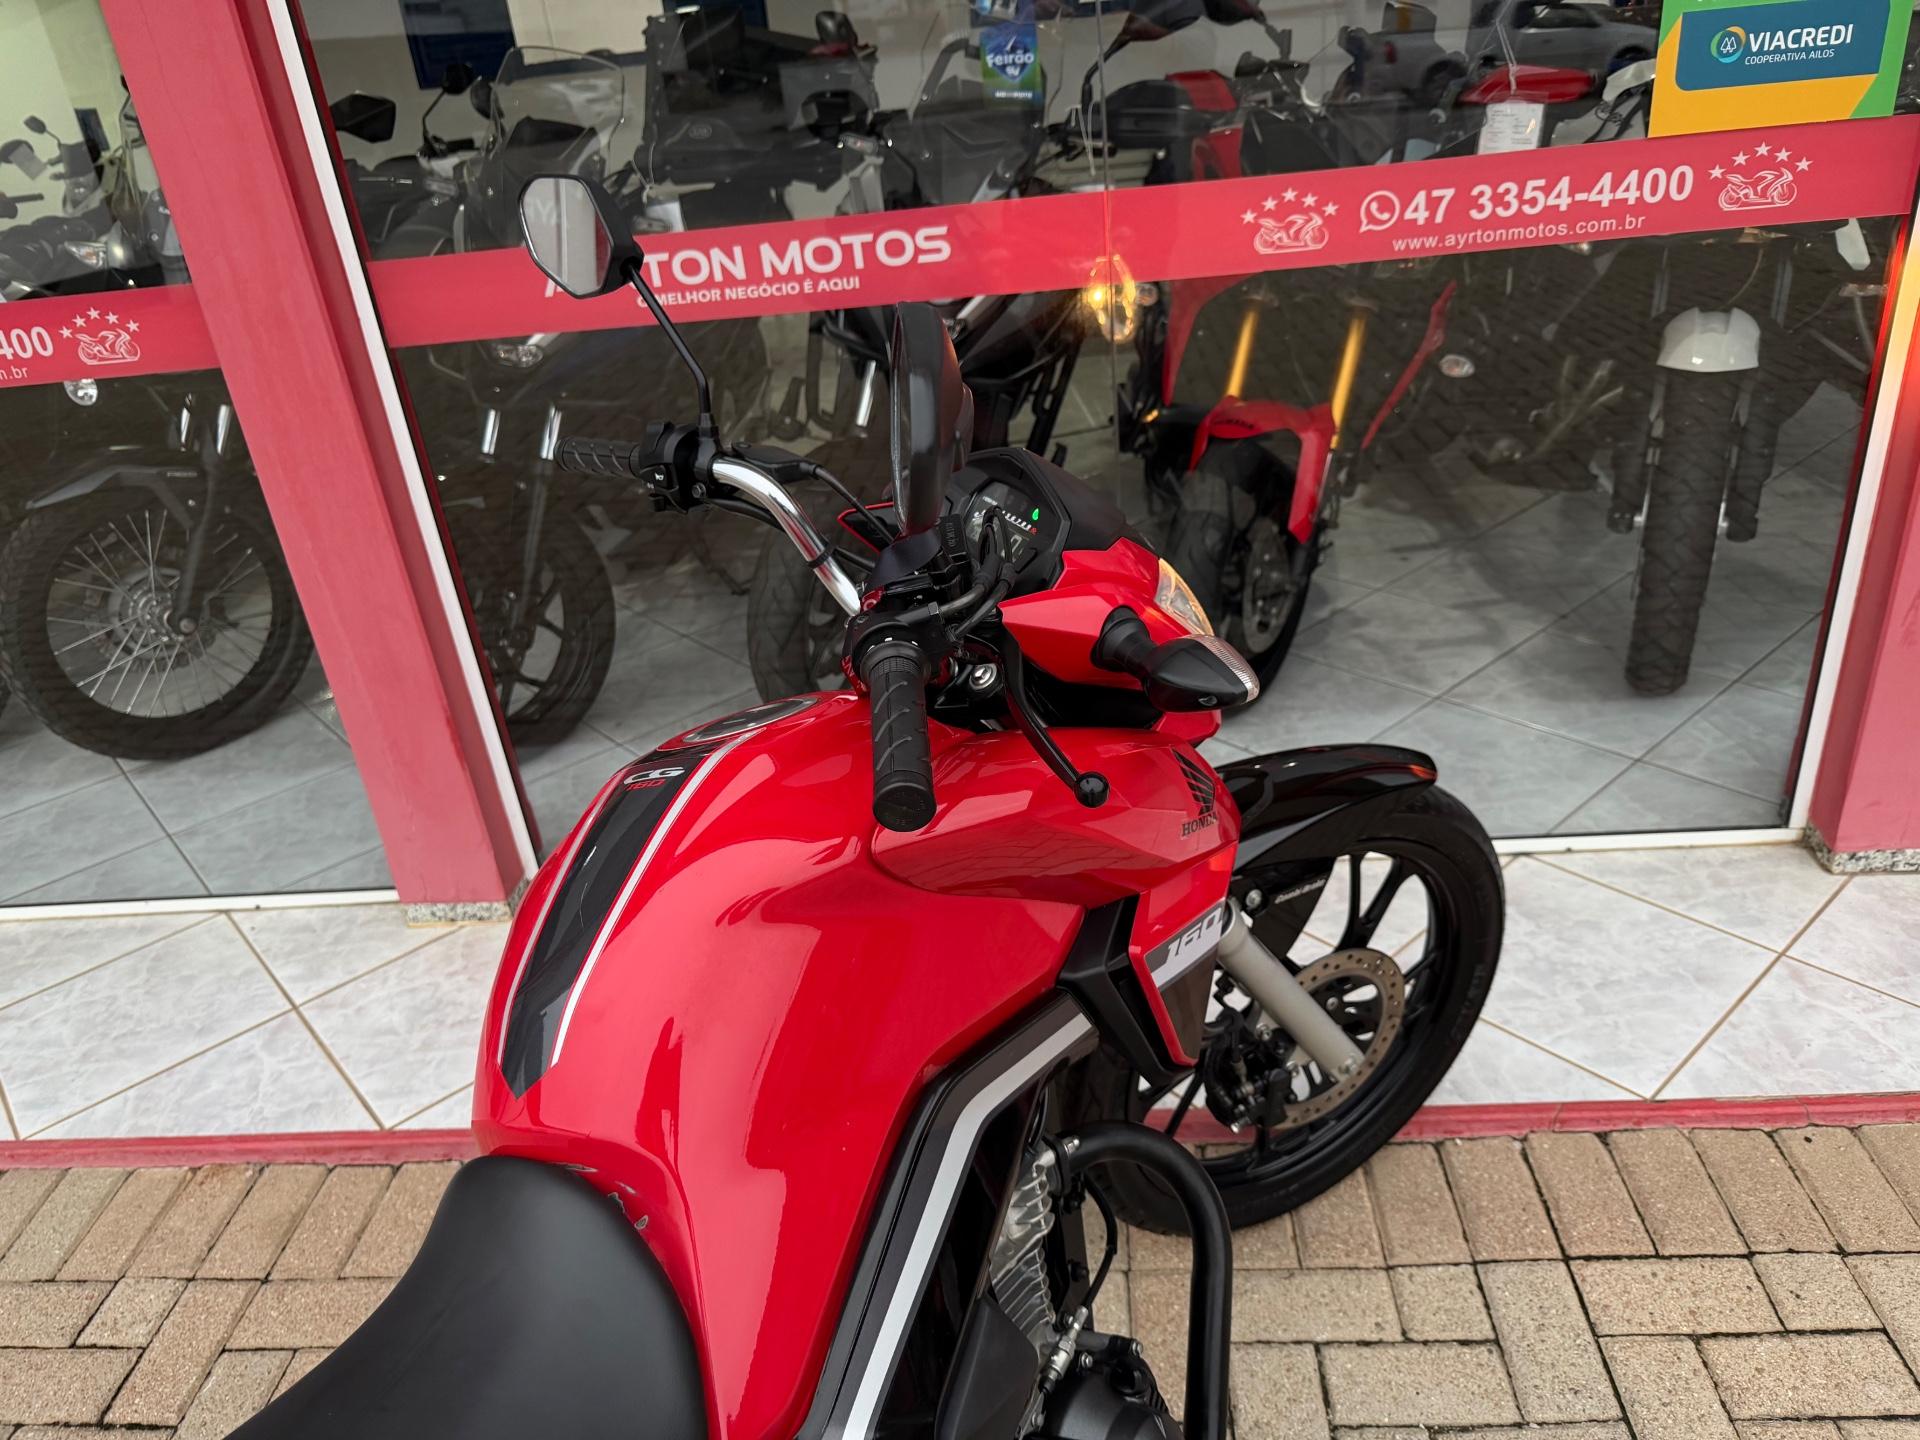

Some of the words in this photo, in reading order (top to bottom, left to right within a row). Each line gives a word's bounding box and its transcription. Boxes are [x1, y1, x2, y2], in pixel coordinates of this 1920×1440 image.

[1749, 23, 1854, 52] VIACREDI
[1744, 52, 1807, 65] COOPERATIVA
[1808, 48, 1836, 59] AILOS
[1403, 188, 1456, 226] 47
[1468, 165, 1694, 220] 3354-4400
[1392, 213, 1646, 252] www.ayrtonmotos.com.br
[759, 226, 952, 278] MOTOS
[655, 289, 722, 307] MELHOR
[725, 280, 801, 301] NEGÓCIO
[803, 278, 814, 294] É
[817, 276, 860, 293] AQUI
[623, 766, 686, 784] CG
[1181, 812, 1218, 837] HONDA
[1166, 907, 1223, 963] 160
